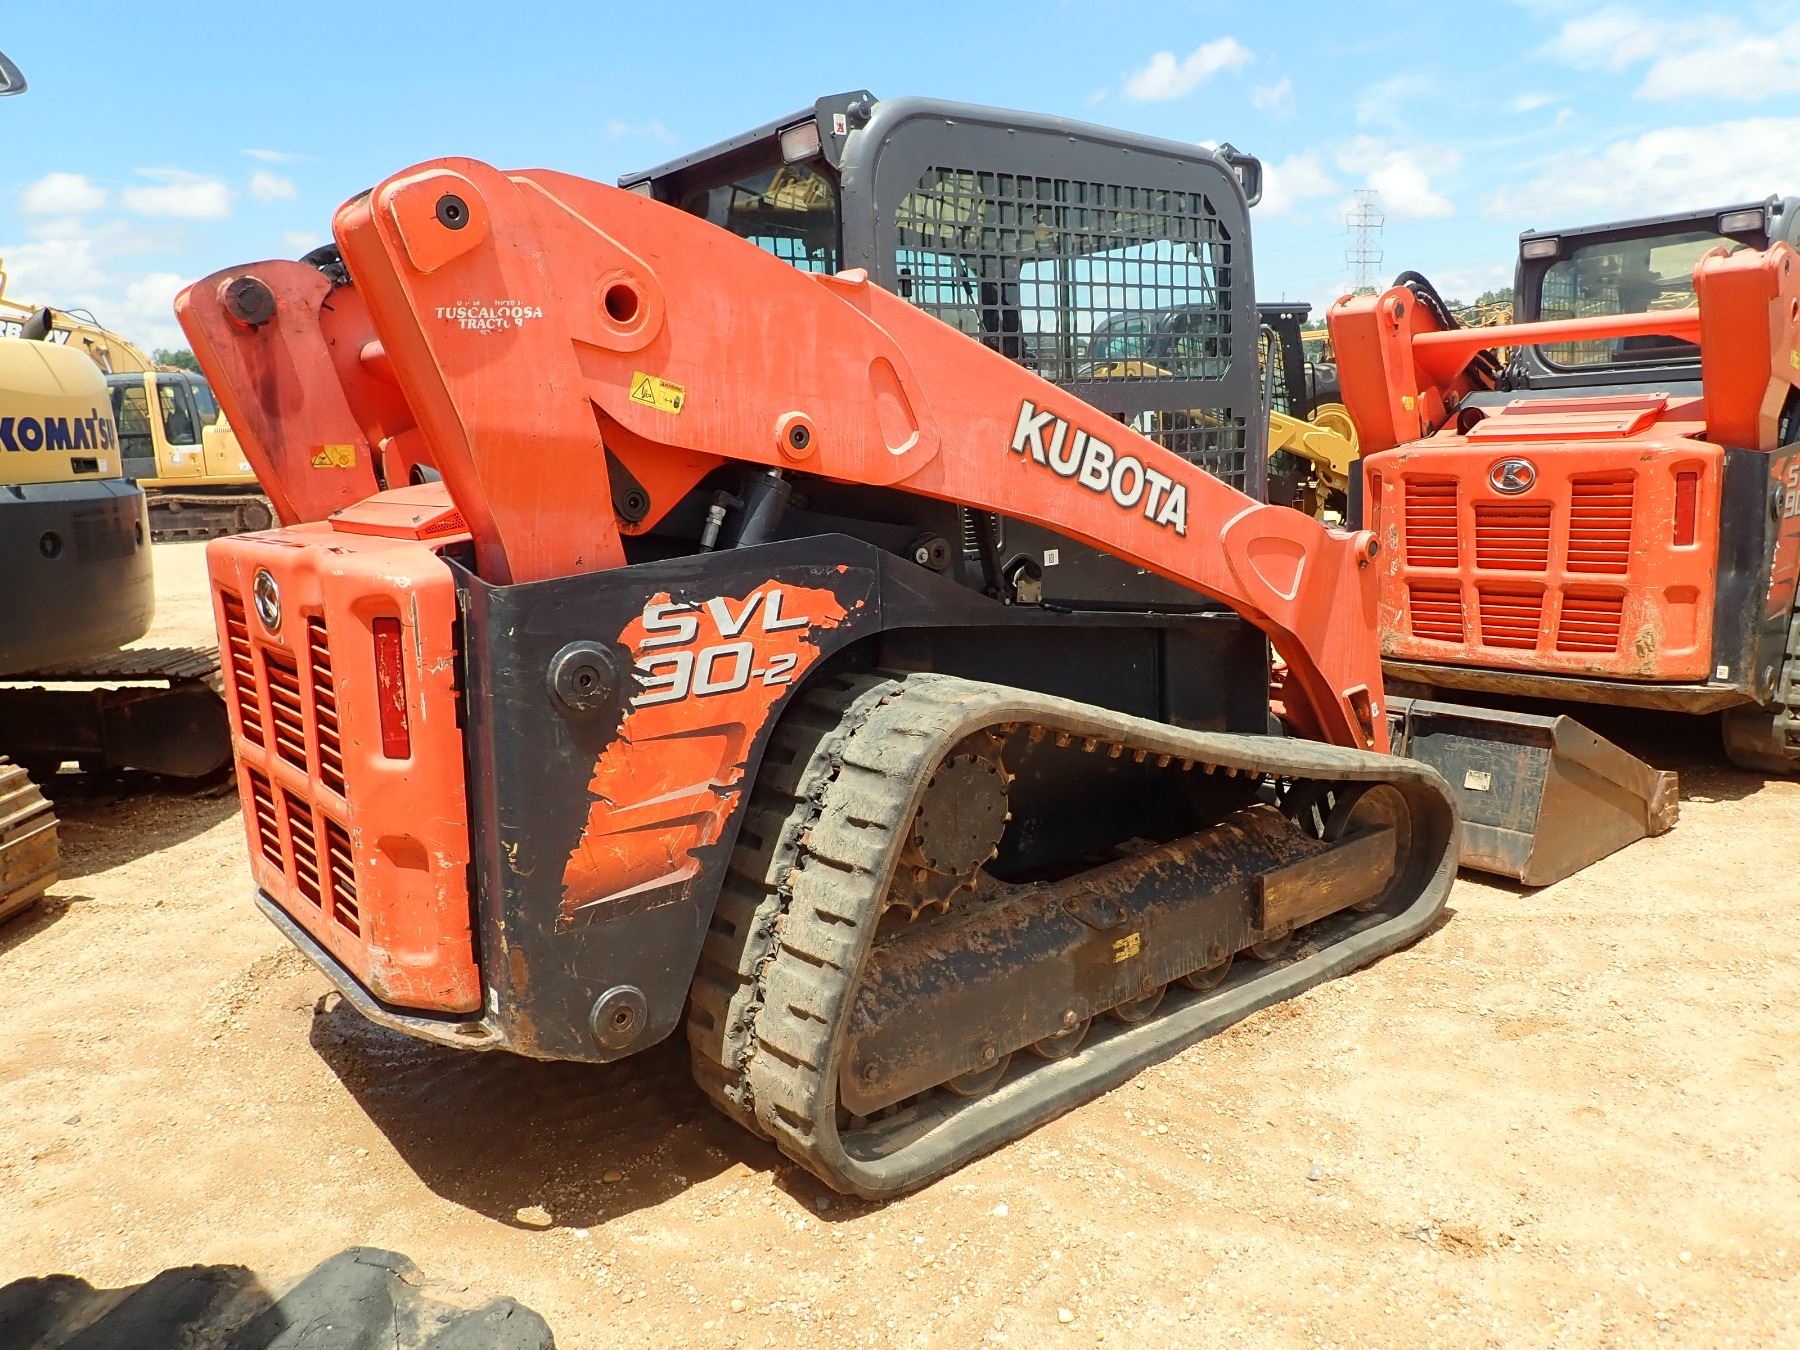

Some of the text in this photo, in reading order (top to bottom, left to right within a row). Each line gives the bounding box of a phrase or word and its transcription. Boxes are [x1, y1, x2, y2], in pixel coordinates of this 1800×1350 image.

[435, 306, 543, 319] TUSCALOOSA
[0, 408, 115, 452] KOMATSU
[1011, 399, 1188, 536] KUBOTA
[638, 589, 811, 649] SVL
[629, 641, 799, 708] 90-2
